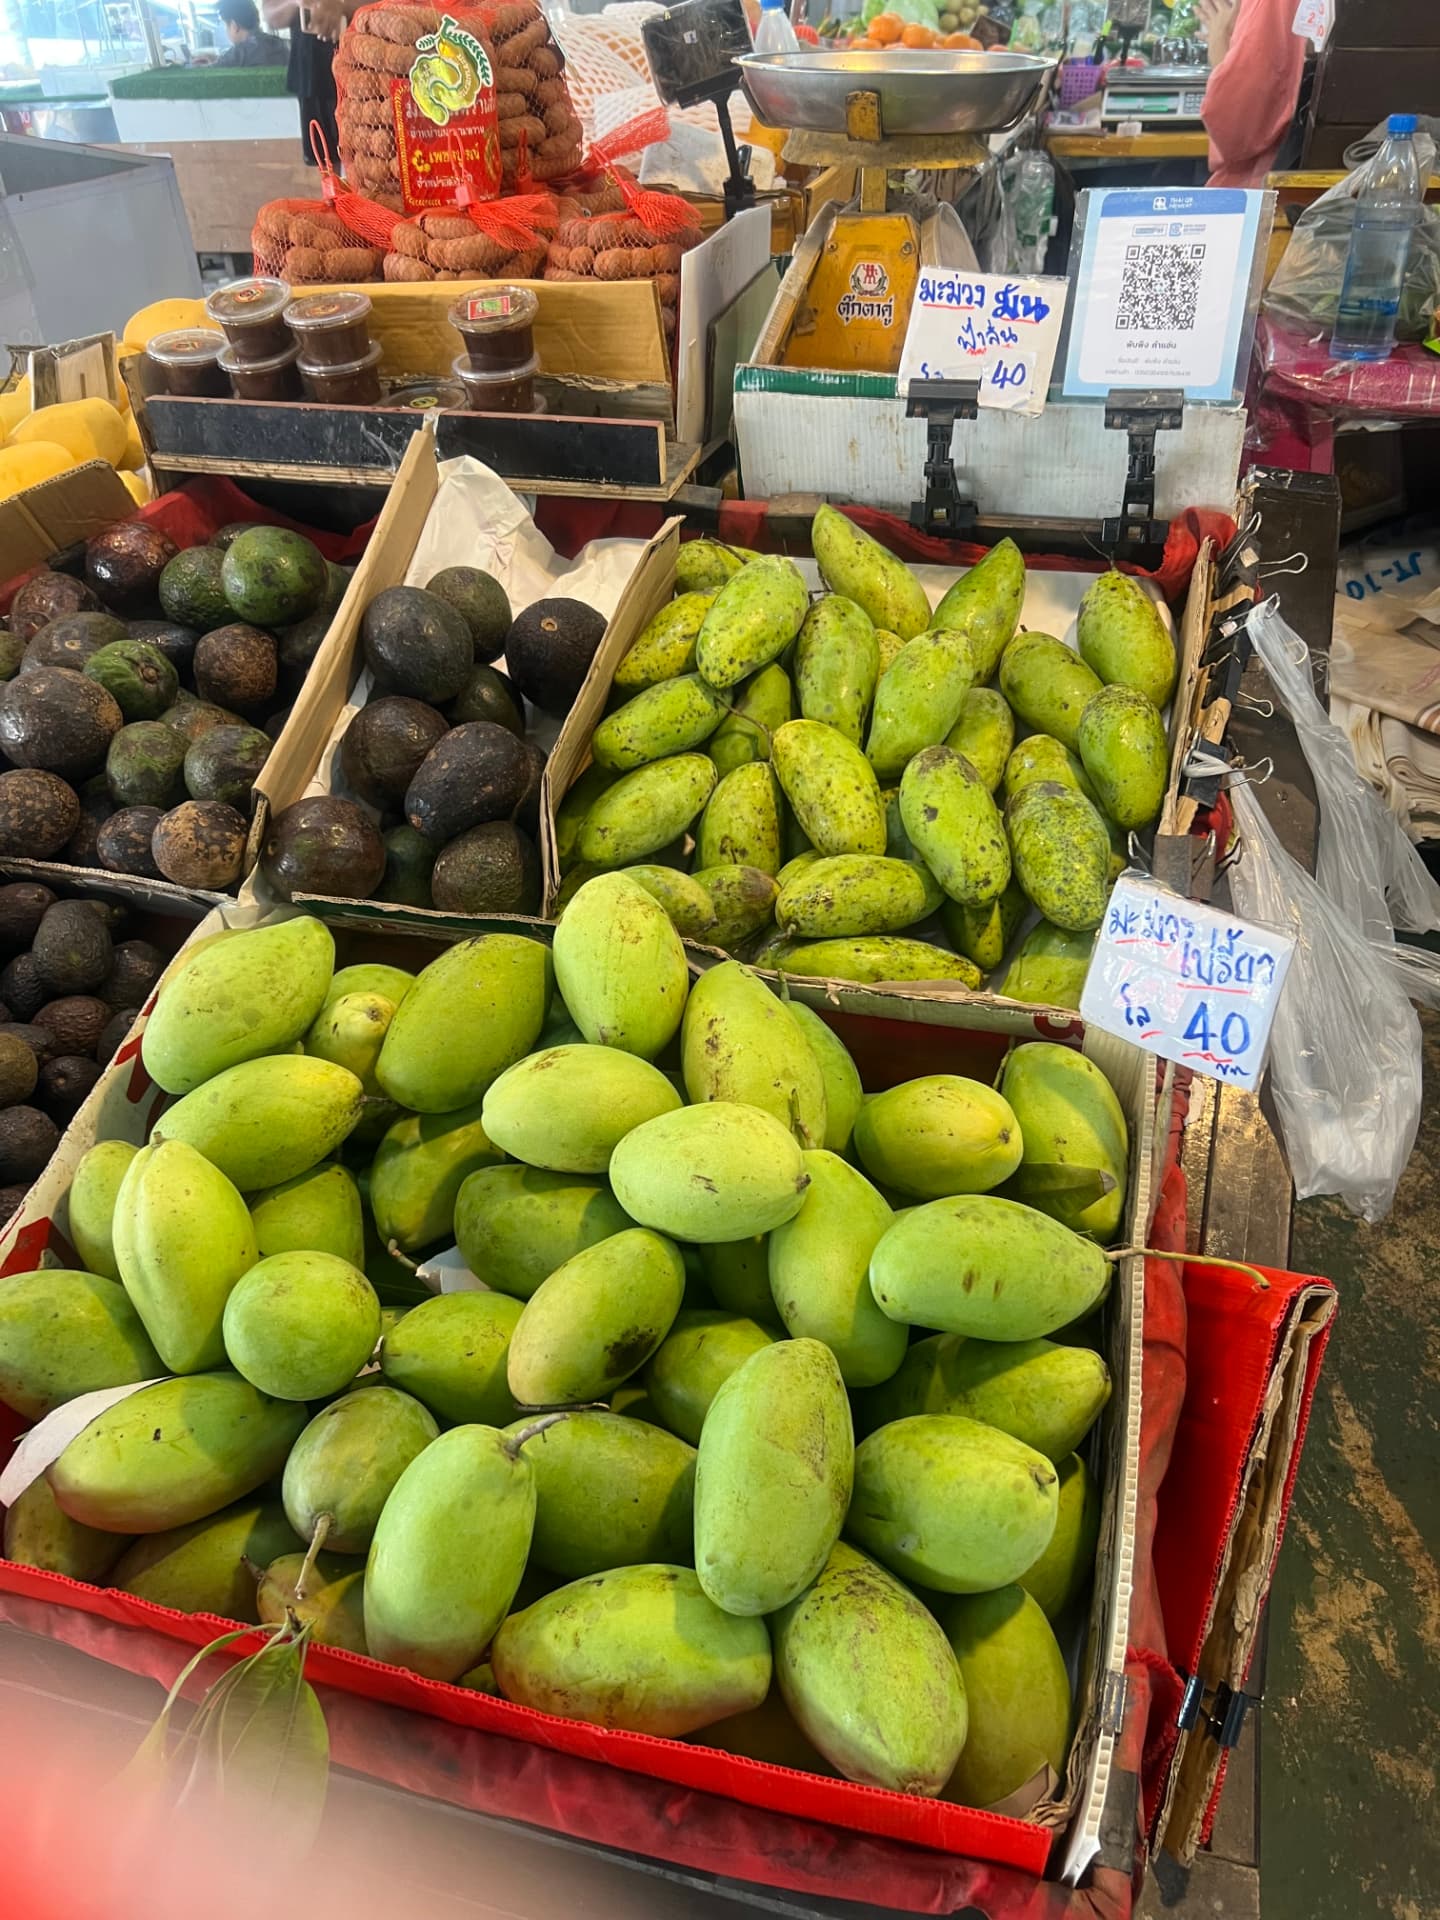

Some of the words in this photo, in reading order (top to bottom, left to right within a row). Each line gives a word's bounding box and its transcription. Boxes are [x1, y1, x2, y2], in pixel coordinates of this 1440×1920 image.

[919, 273, 986, 308] มะม่วง
[838, 294, 893, 326] ตุ๊กตาคู่
[991, 360, 1026, 389] 40
[1182, 1001, 1251, 1055] 40
